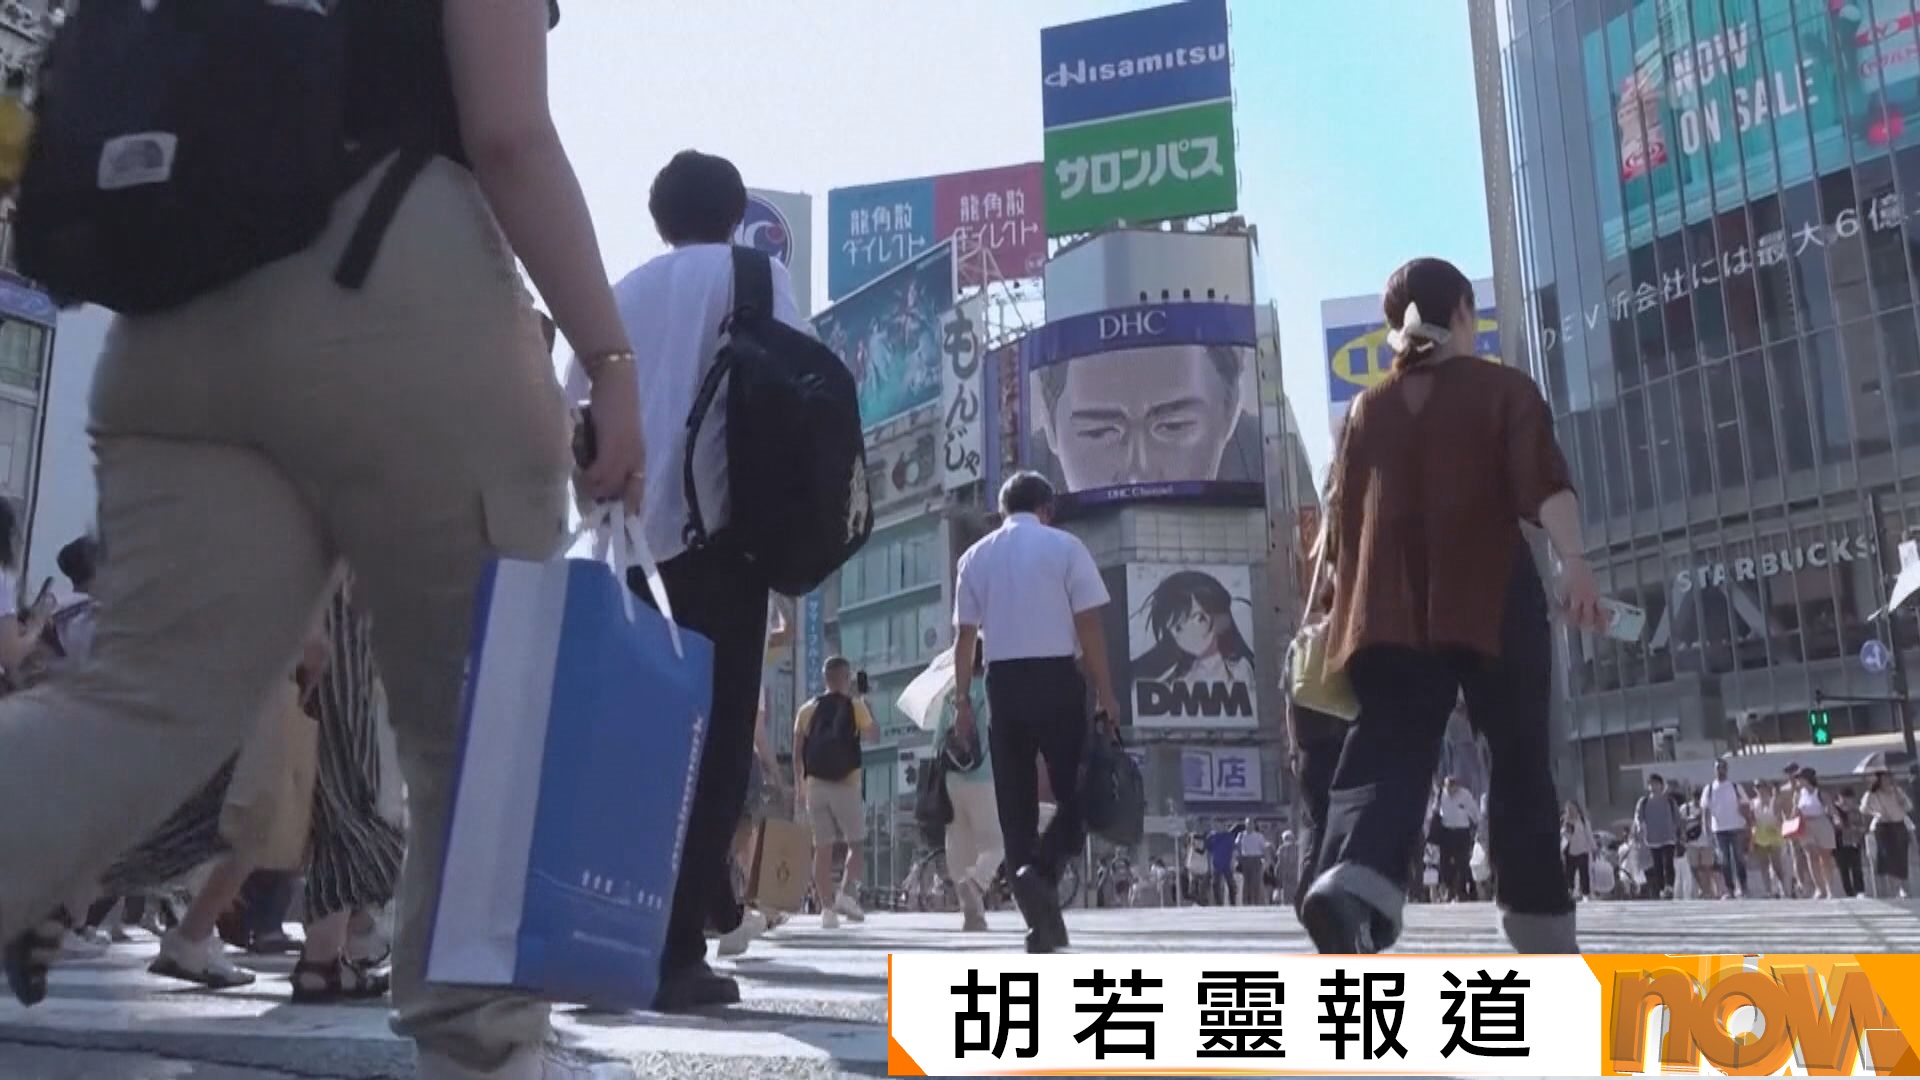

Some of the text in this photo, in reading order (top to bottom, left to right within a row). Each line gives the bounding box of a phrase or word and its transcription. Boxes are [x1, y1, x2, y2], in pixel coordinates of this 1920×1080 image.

[1044, 42, 1226, 87] Hisamitsu
[1672, 22, 1747, 97] NOW
[1680, 98, 1721, 155] ON
[1735, 58, 1819, 132] SALE
[1055, 136, 1224, 199] サロンパス
[851, 203, 914, 237] 龍角散
[960, 188, 1025, 222] 龍角散
[1100, 310, 1167, 339] DHC
[944, 308, 980, 478] もんじゃ
[1677, 533, 1877, 593] STARBUCKS
[1136, 681, 1253, 717] DMM
